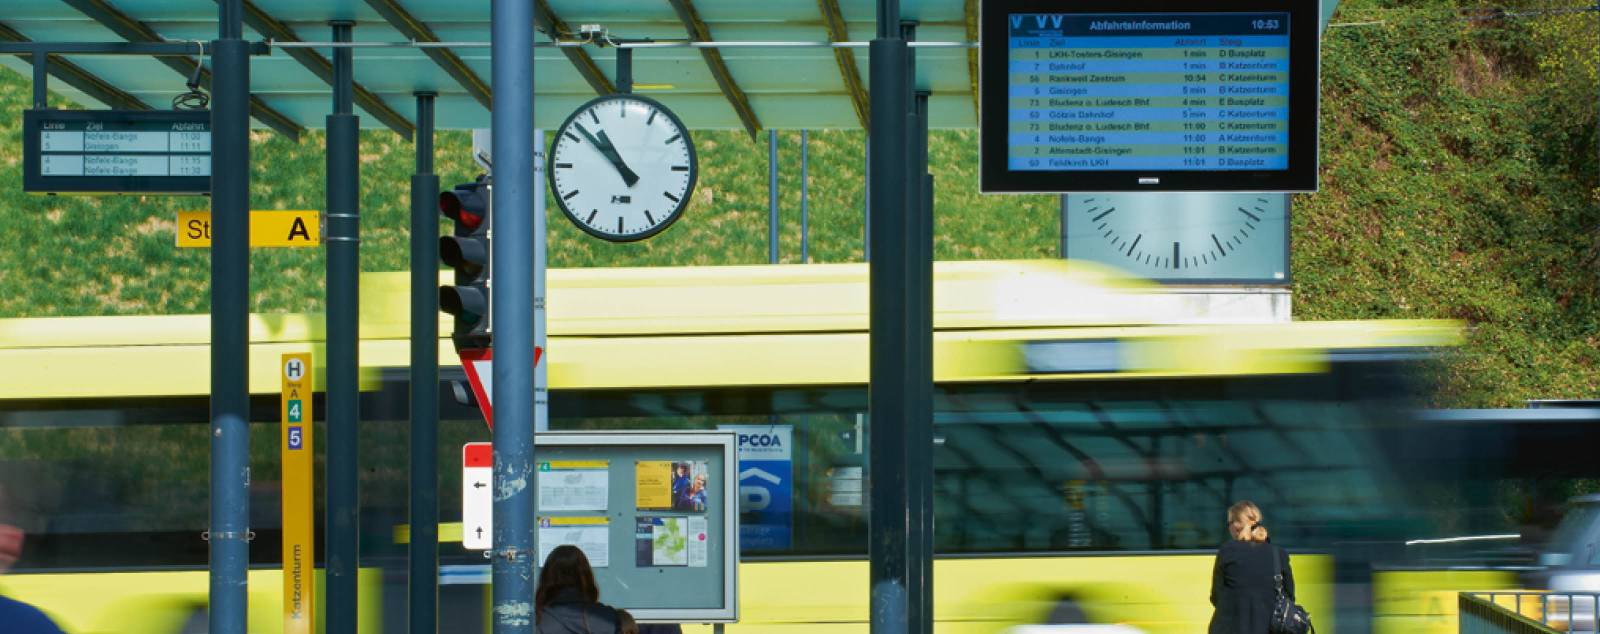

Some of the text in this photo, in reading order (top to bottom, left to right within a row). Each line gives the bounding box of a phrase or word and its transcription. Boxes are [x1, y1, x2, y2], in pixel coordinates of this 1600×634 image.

[1089, 19, 1191, 31] Abfahrtsinformation
[1252, 19, 1280, 30] 10:53
[1190, 49, 1207, 57] min
[1219, 49, 1226, 57] D
[1228, 48, 1266, 59] Busplatz
[1048, 62, 1086, 70] Bahnhof
[1190, 61, 1207, 69] min
[1228, 61, 1277, 69] Katzenturm
[1048, 74, 1088, 82] Rankweil
[1089, 74, 1126, 82] Zentrum
[1184, 73, 1206, 82] 10:54
[1219, 73, 1226, 81] C
[1228, 73, 1277, 81] Katzenturm
[1048, 87, 1088, 96] Gisingen
[1189, 86, 1206, 94] min
[1228, 86, 1277, 94] Katzenturm
[1048, 98, 1083, 106] Bludenz
[1096, 98, 1132, 106] Ludesch
[1134, 98, 1150, 106] Bhf
[1189, 98, 1206, 106] min
[1227, 98, 1265, 108] Busplatz
[1078, 111, 1114, 119] Bahnhof
[1189, 110, 1206, 118] min
[1228, 110, 1277, 118] Katzenturm
[43, 120, 205, 130] Linie Ziel Abfahrt
[1048, 122, 1083, 130] Bludenz
[1096, 122, 1132, 130] Ludesch
[1134, 122, 1150, 130] Bhf
[1183, 122, 1206, 130] 11:00
[1219, 122, 1226, 130] C
[1228, 122, 1277, 130] Katzenturm
[85, 132, 138, 142] Nofels-Bangs
[1048, 135, 1106, 145] Nofels-Bangs
[1183, 134, 1206, 142] 11:00
[1218, 134, 1226, 142] A
[1227, 134, 1277, 142] Katzenturm
[1048, 146, 1132, 156] Altenstadt-Gisingen
[1183, 146, 1205, 154] 11:01
[1219, 146, 1226, 154] B
[1227, 146, 1277, 154] Katzenturm
[85, 156, 138, 166] Nofels-Bangs
[1048, 158, 1088, 167] Feldkirch
[1183, 158, 1205, 166] 11:01
[1227, 158, 1265, 168] Busplatz
[85, 166, 138, 175] Nofels-Bangs
[287, 216, 310, 241] A
[287, 361, 301, 377] H
[290, 388, 298, 398] A
[289, 403, 300, 420] 4
[289, 430, 300, 446] 5
[739, 433, 781, 447] PCOA
[292, 544, 301, 619] Katzenturm
